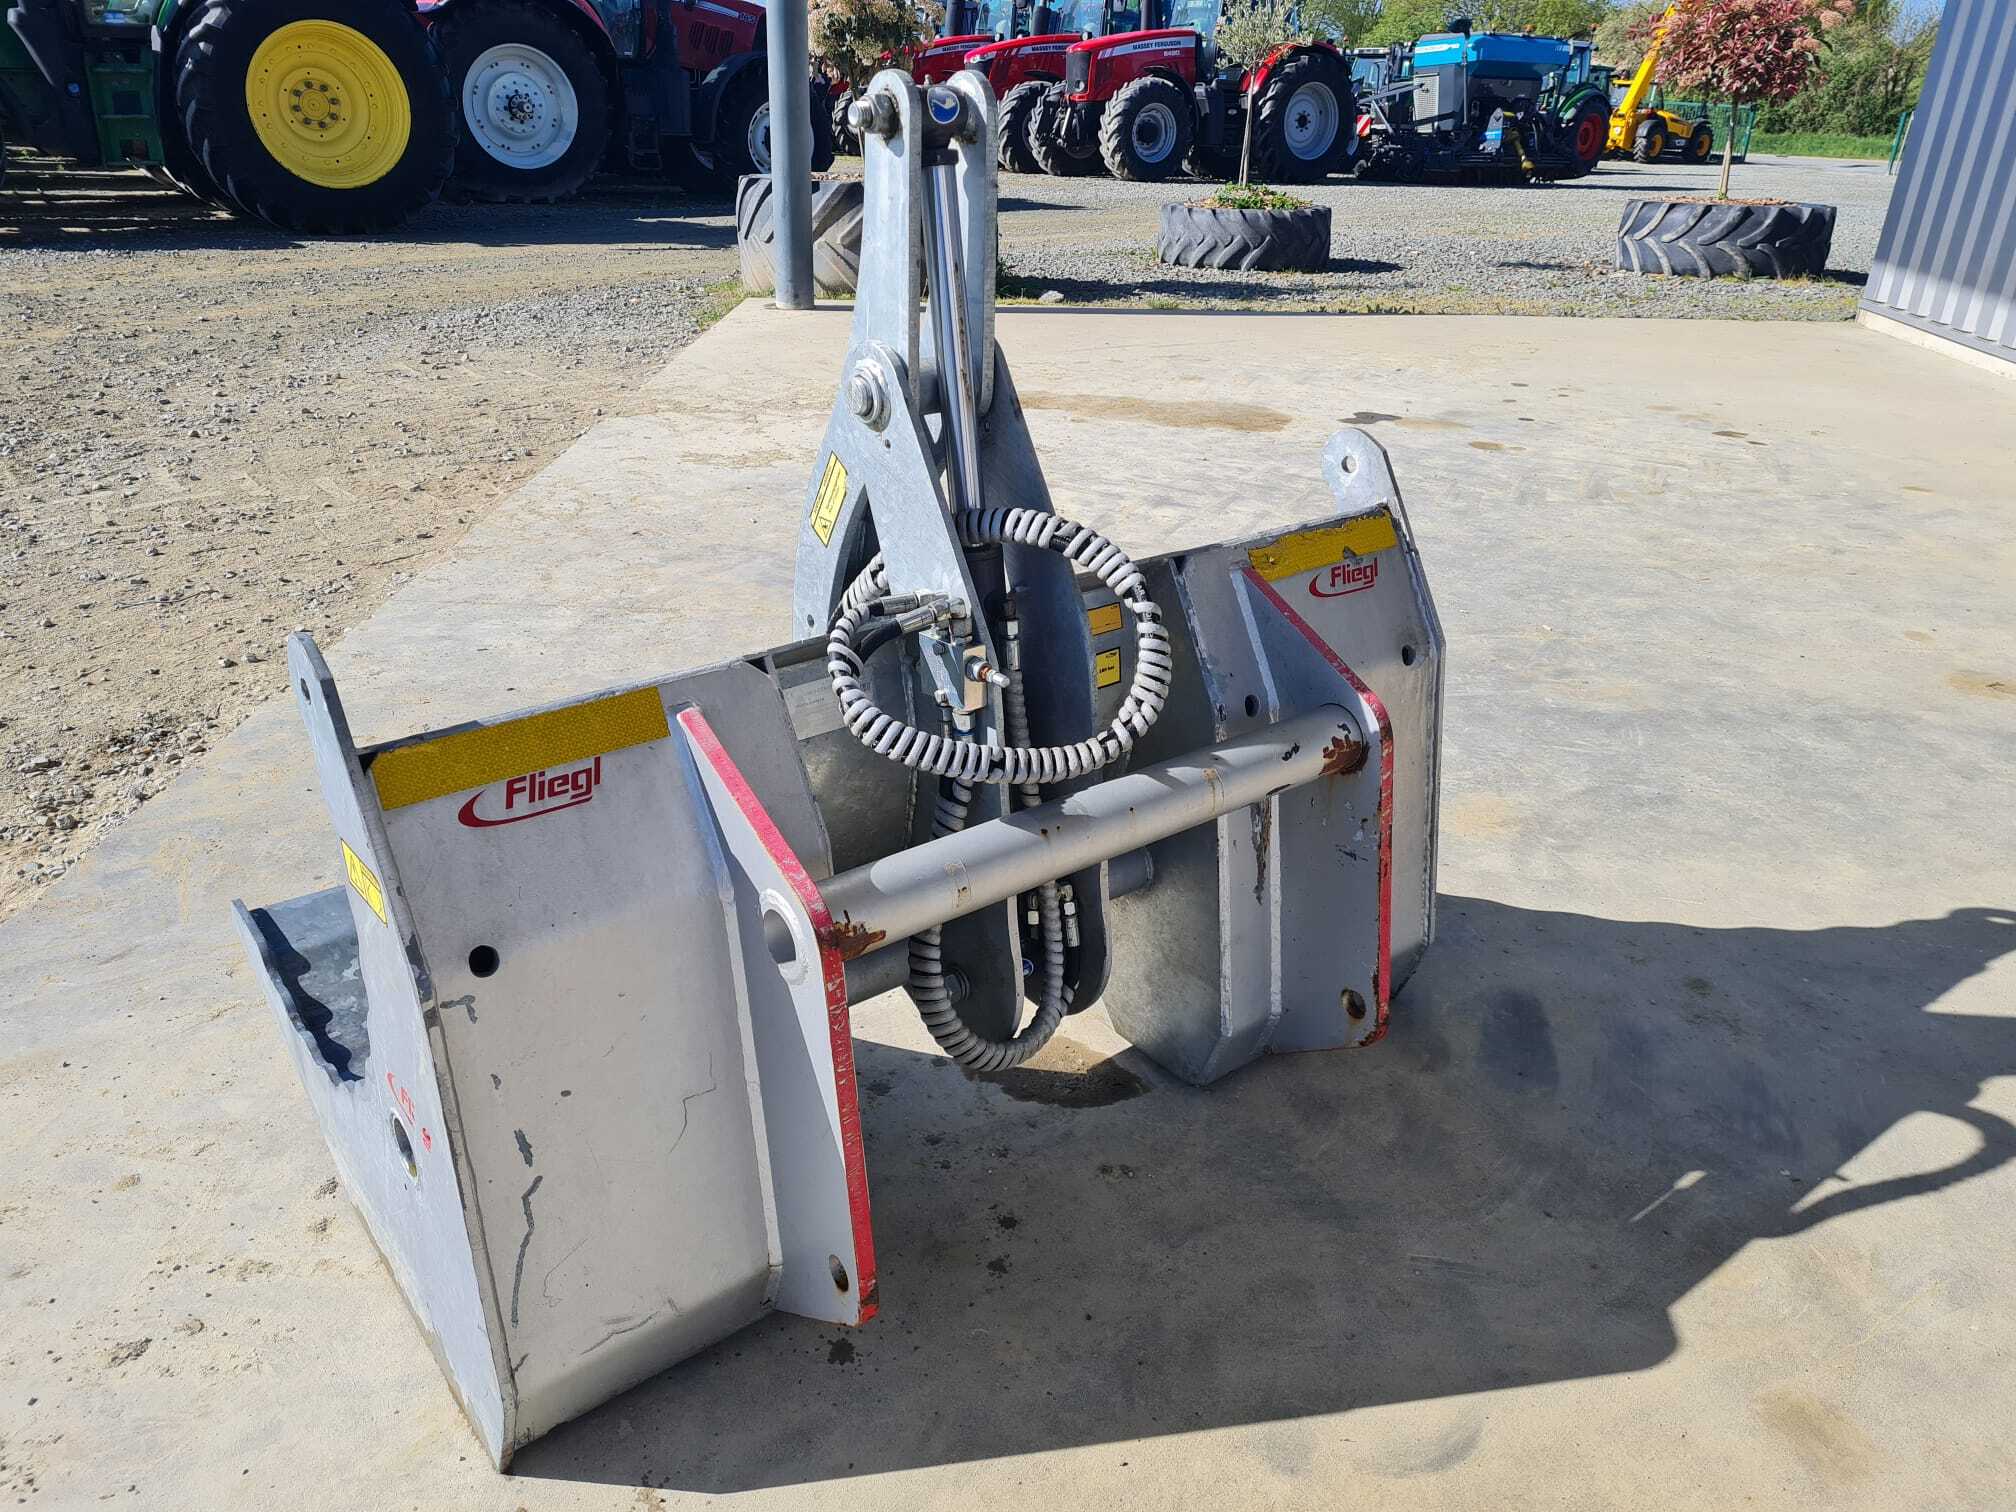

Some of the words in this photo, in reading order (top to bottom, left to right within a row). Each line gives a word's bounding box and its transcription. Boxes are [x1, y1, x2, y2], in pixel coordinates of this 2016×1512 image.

[1031, 44, 1052, 52] MASSEY
[1132, 41, 1154, 50] MASSEY
[1154, 39, 1182, 48] FERGUSON
[1329, 556, 1379, 588] Fliegl
[504, 755, 602, 811] Fliegl
